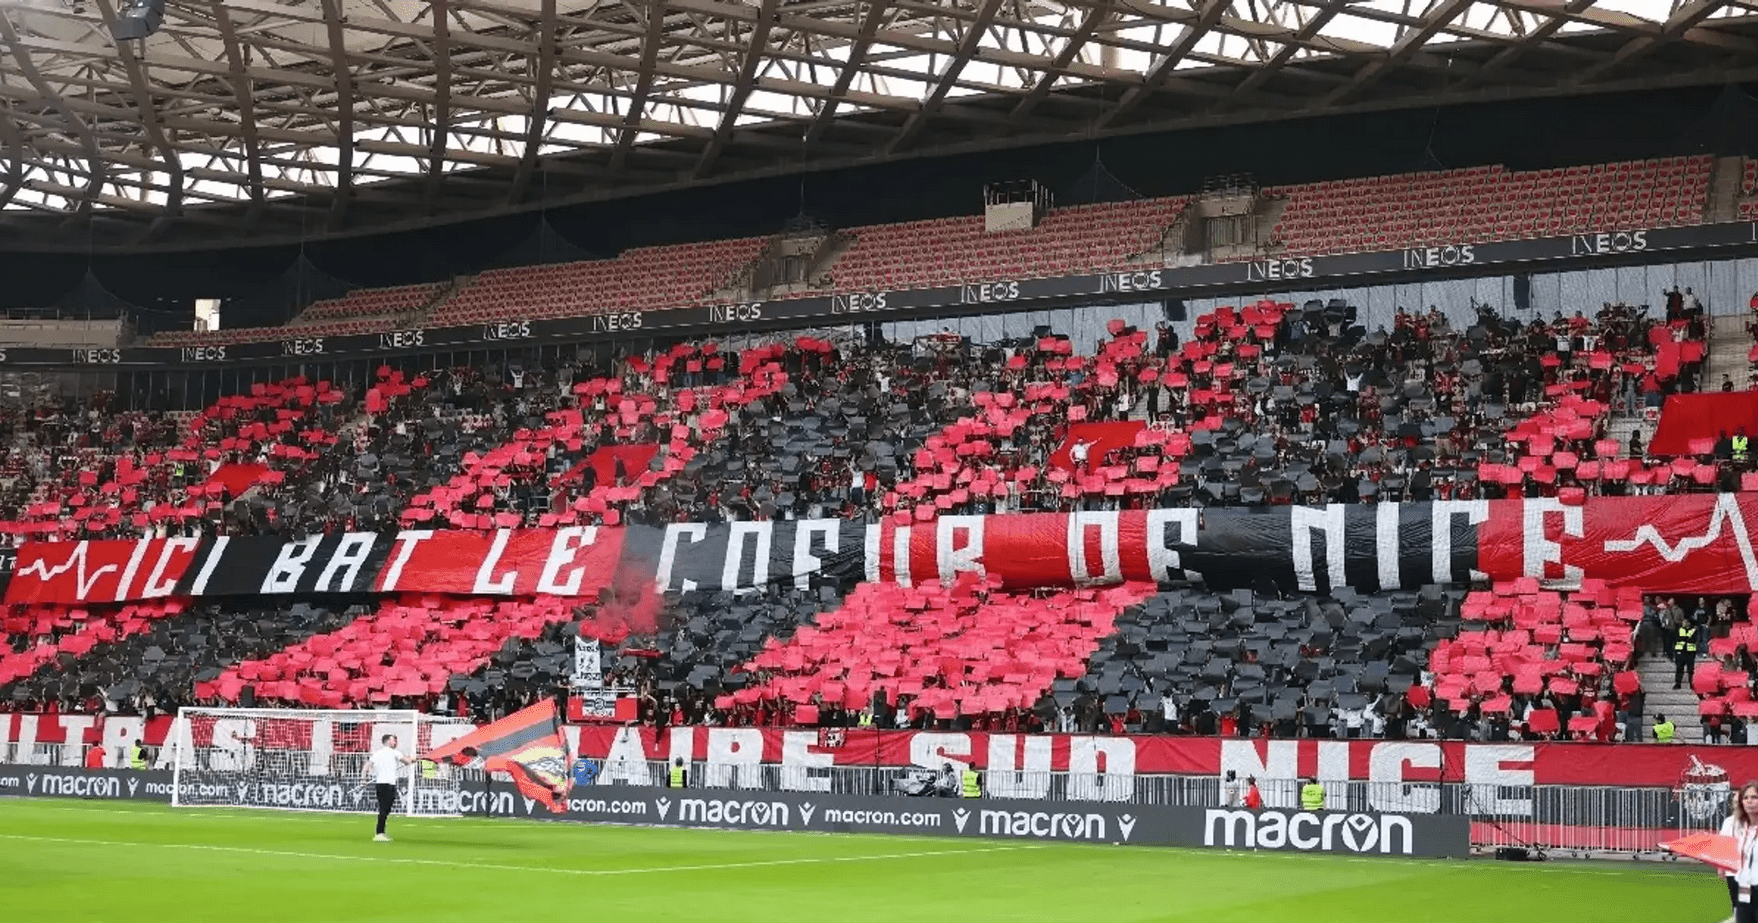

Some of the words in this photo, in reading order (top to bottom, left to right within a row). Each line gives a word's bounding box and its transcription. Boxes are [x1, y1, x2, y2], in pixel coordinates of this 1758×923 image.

[380, 330, 424, 348] INEOS
[482, 321, 530, 340] INEOS
[593, 312, 642, 331] INEOS
[710, 304, 761, 322] INEOS
[831, 293, 886, 313] INEOS
[962, 282, 1020, 302] INEOS
[1101, 271, 1162, 293] INEOS
[1248, 259, 1313, 281] INEOS
[1403, 246, 1475, 268] INEOS
[1573, 231, 1647, 254] INEOS
[114, 535, 230, 601] ICI
[259, 530, 433, 594] BAT
[472, 526, 597, 595] LE
[1067, 508, 1204, 587] DE
[1291, 497, 1584, 592] NICE
[0, 714, 256, 771] LTRAS
[1220, 739, 1535, 815] NICE
[42, 774, 120, 797] macron
[679, 799, 789, 826] macron
[825, 807, 941, 827] macron.com
[980, 809, 1105, 839] macron
[1204, 809, 1413, 854] macron
